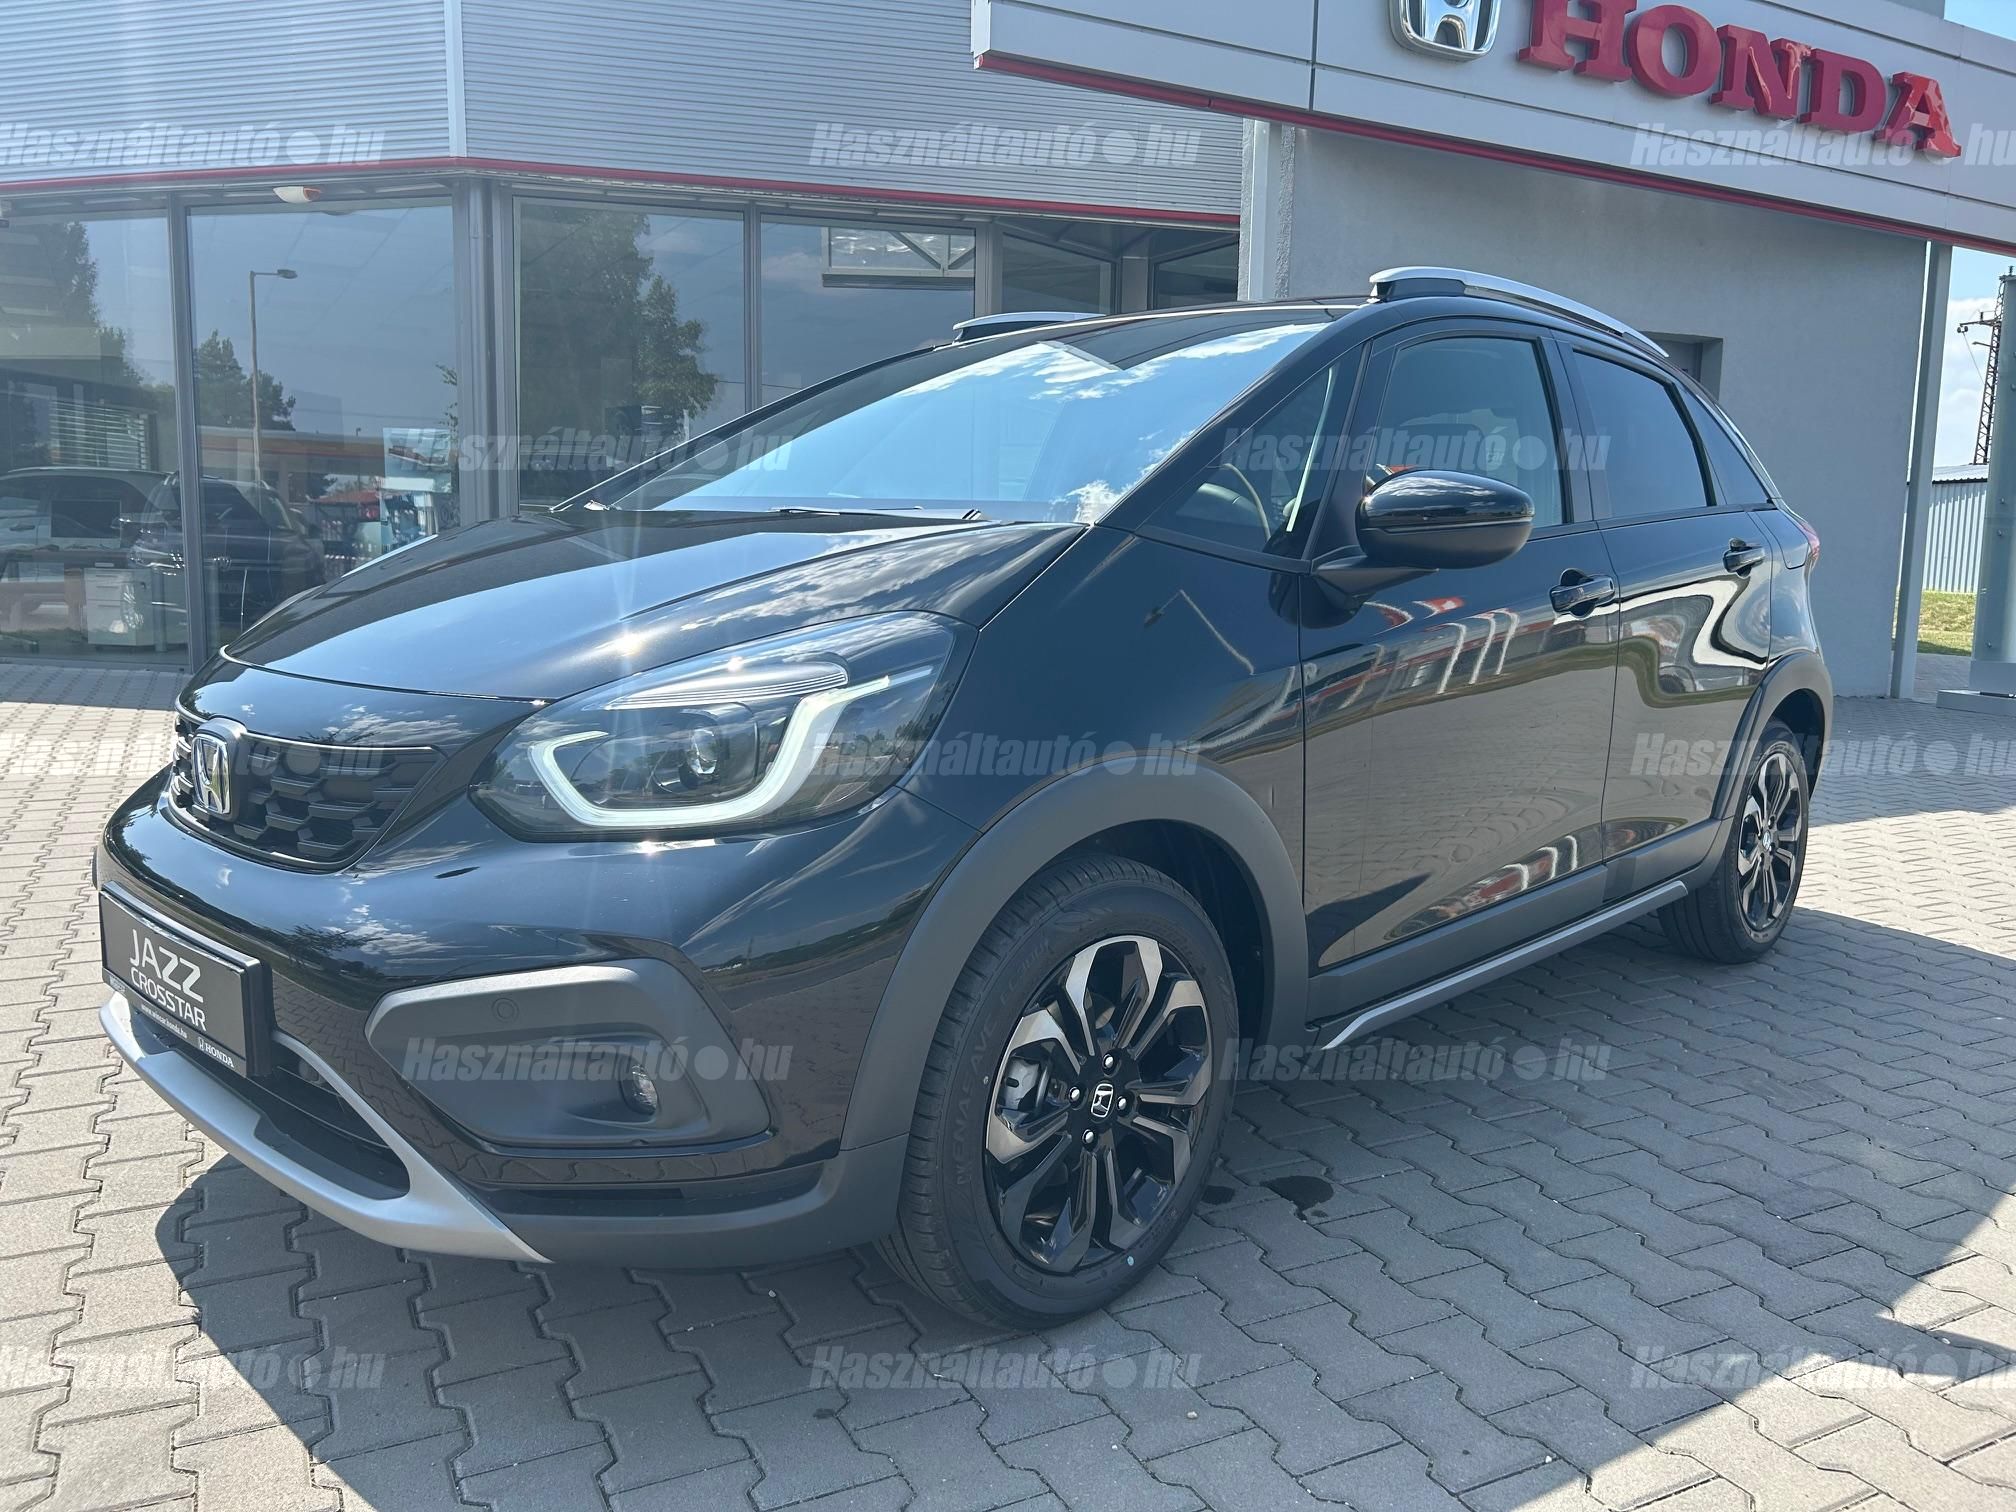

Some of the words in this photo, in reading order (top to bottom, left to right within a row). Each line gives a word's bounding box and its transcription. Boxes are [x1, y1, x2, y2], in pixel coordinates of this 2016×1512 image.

[1518, 0, 1962, 158] HONDA
[130, 929, 204, 1003] JAZZ
[130, 967, 207, 1031] CROSSTAR
[204, 1042, 235, 1068] HONDA
